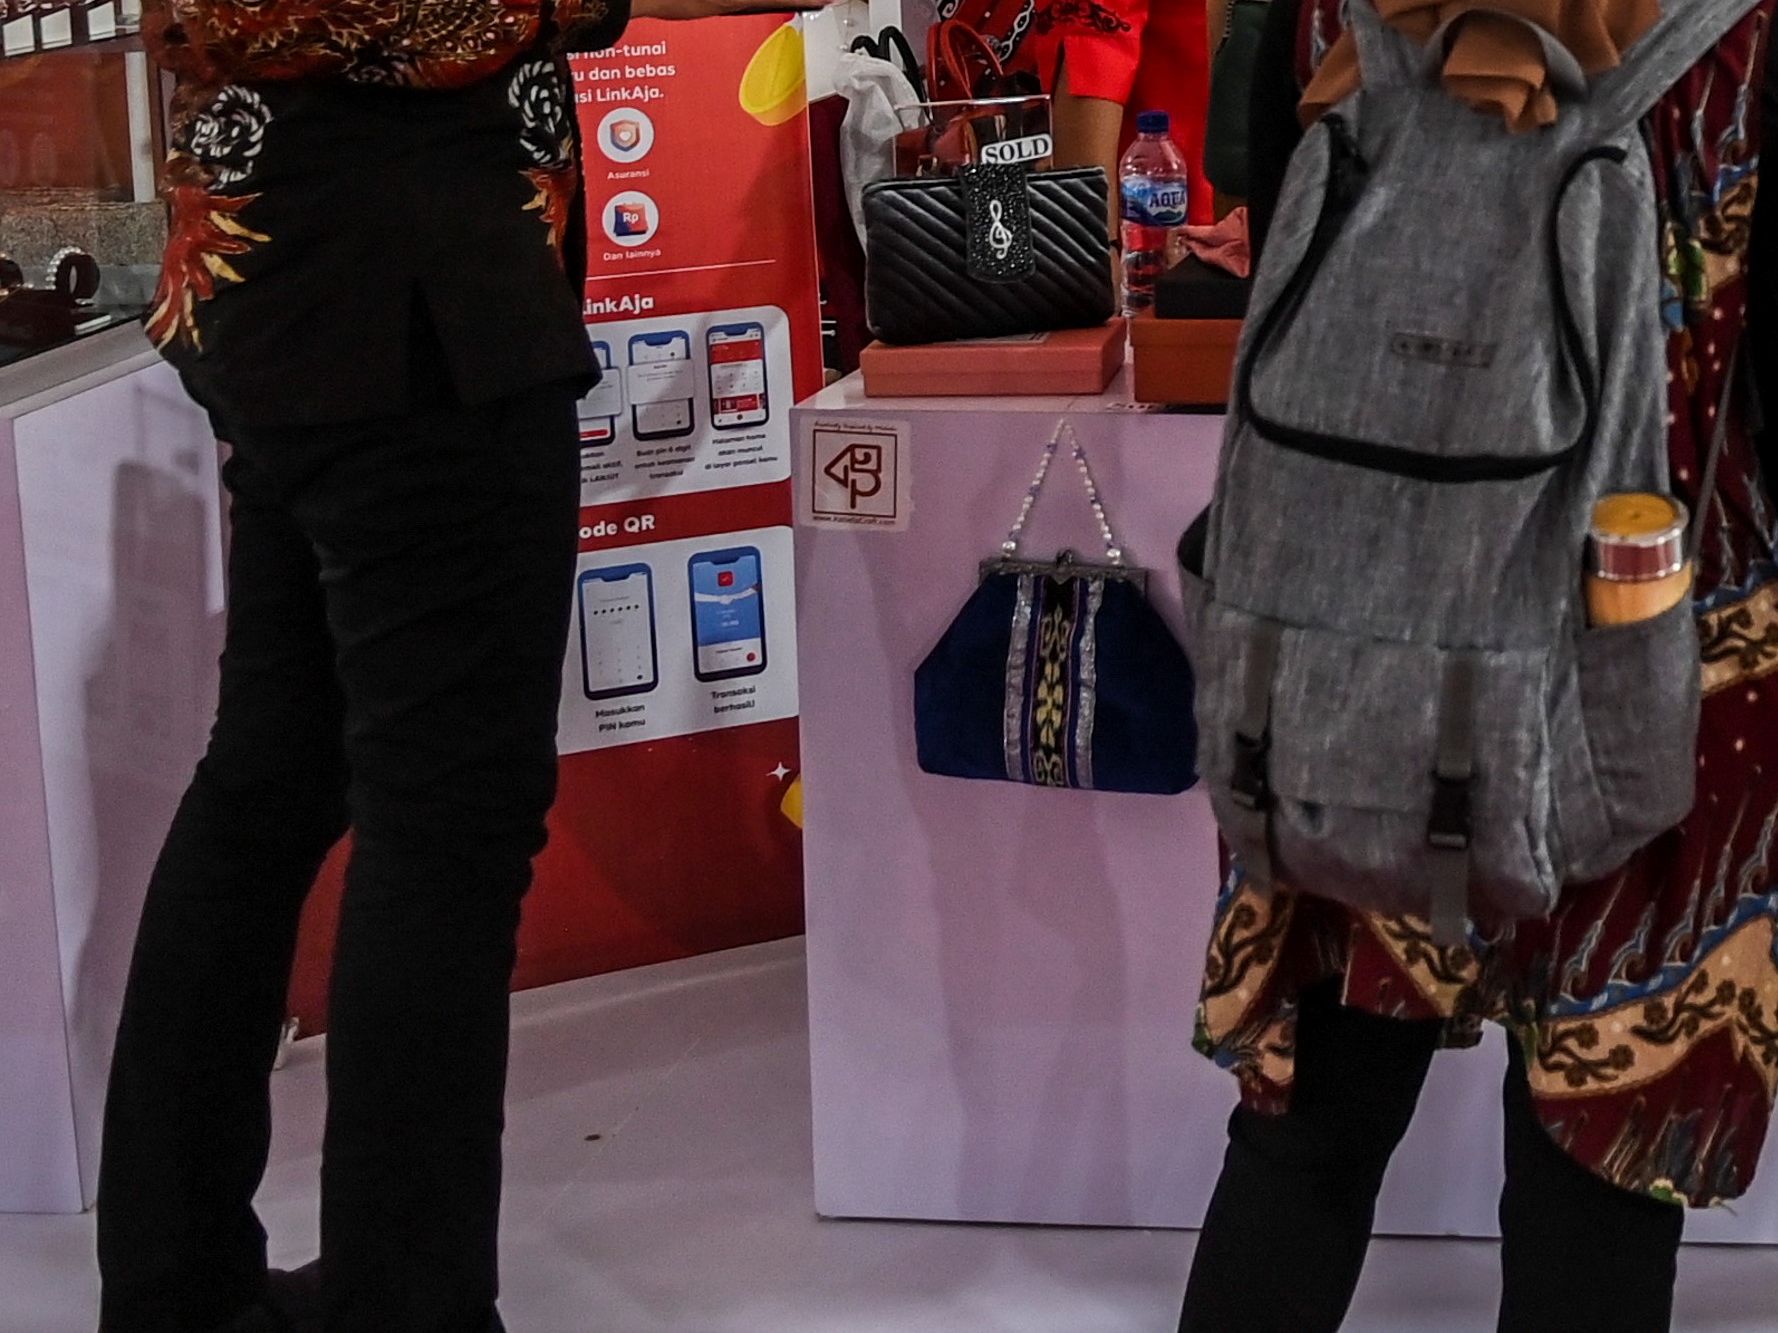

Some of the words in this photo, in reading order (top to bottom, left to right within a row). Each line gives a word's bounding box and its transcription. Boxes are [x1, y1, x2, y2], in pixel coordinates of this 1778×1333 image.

[588, 66, 621, 81] dan
[624, 63, 677, 79] bebas
[596, 84, 665, 103] LinkAja.
[984, 137, 1050, 164] SOLD
[607, 168, 650, 181] Asuransi
[622, 211, 639, 225] Rp
[603, 251, 624, 262] Dan
[623, 514, 656, 534] QR
